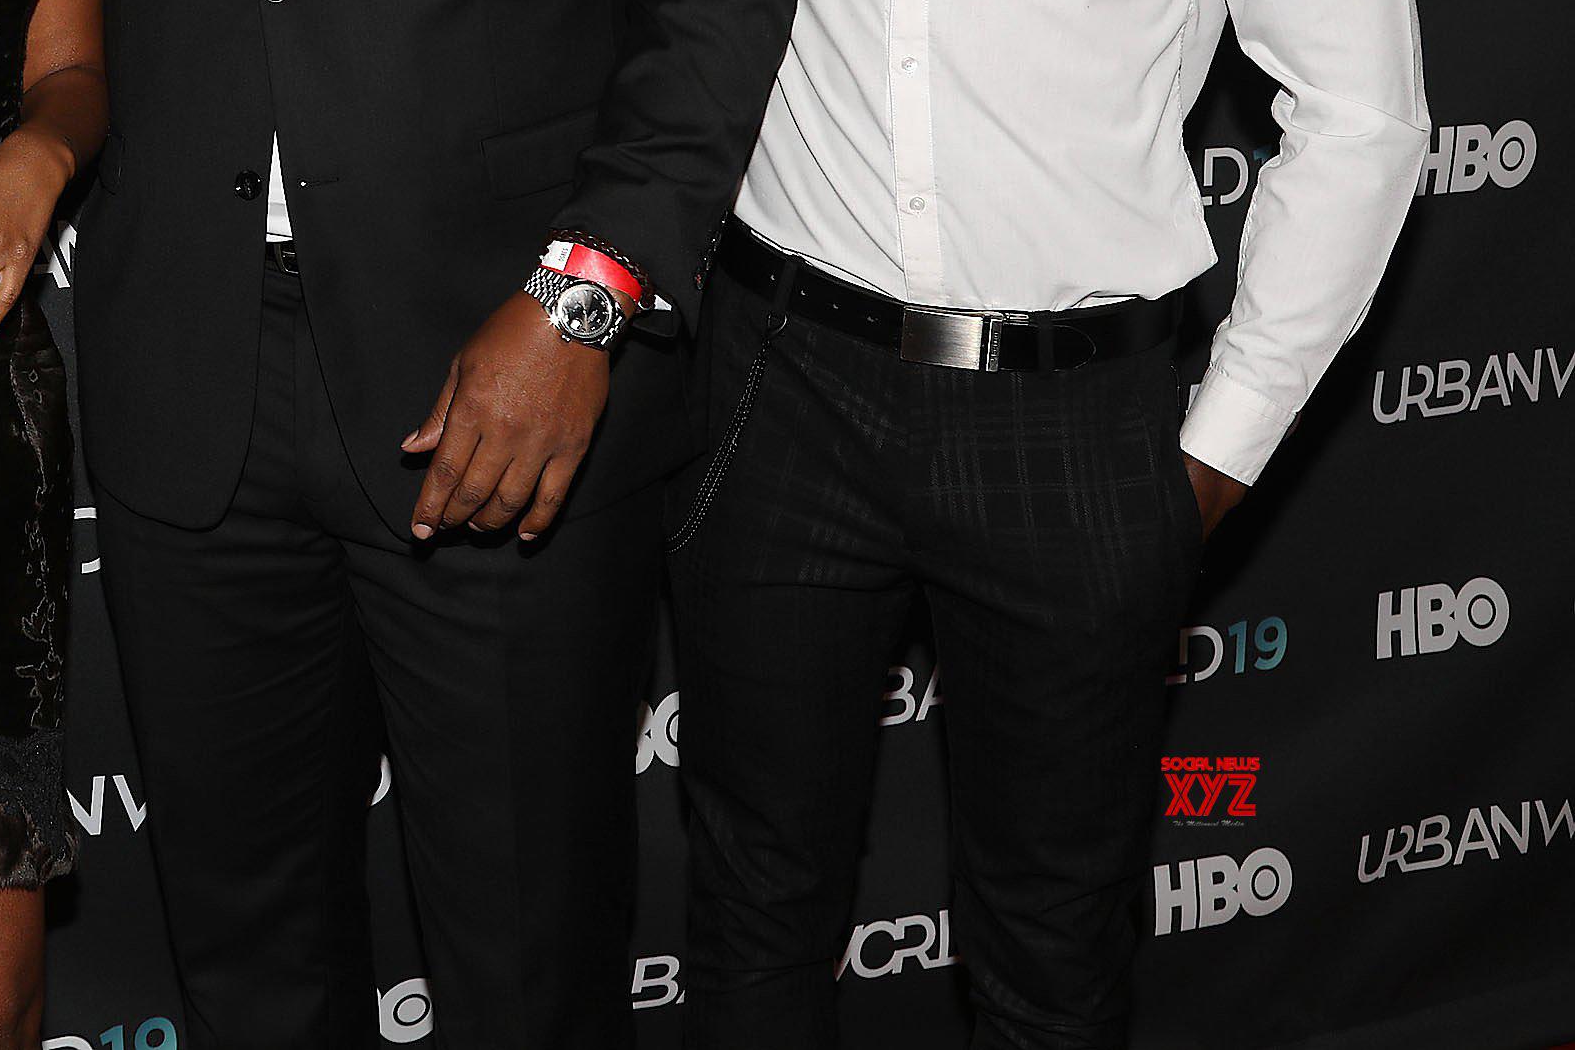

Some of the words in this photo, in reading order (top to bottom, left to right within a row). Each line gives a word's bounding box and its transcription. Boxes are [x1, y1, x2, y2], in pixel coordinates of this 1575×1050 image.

[1418, 119, 1537, 196] HBO
[1376, 576, 1509, 660] HBO
[1154, 847, 1293, 937] HBO
